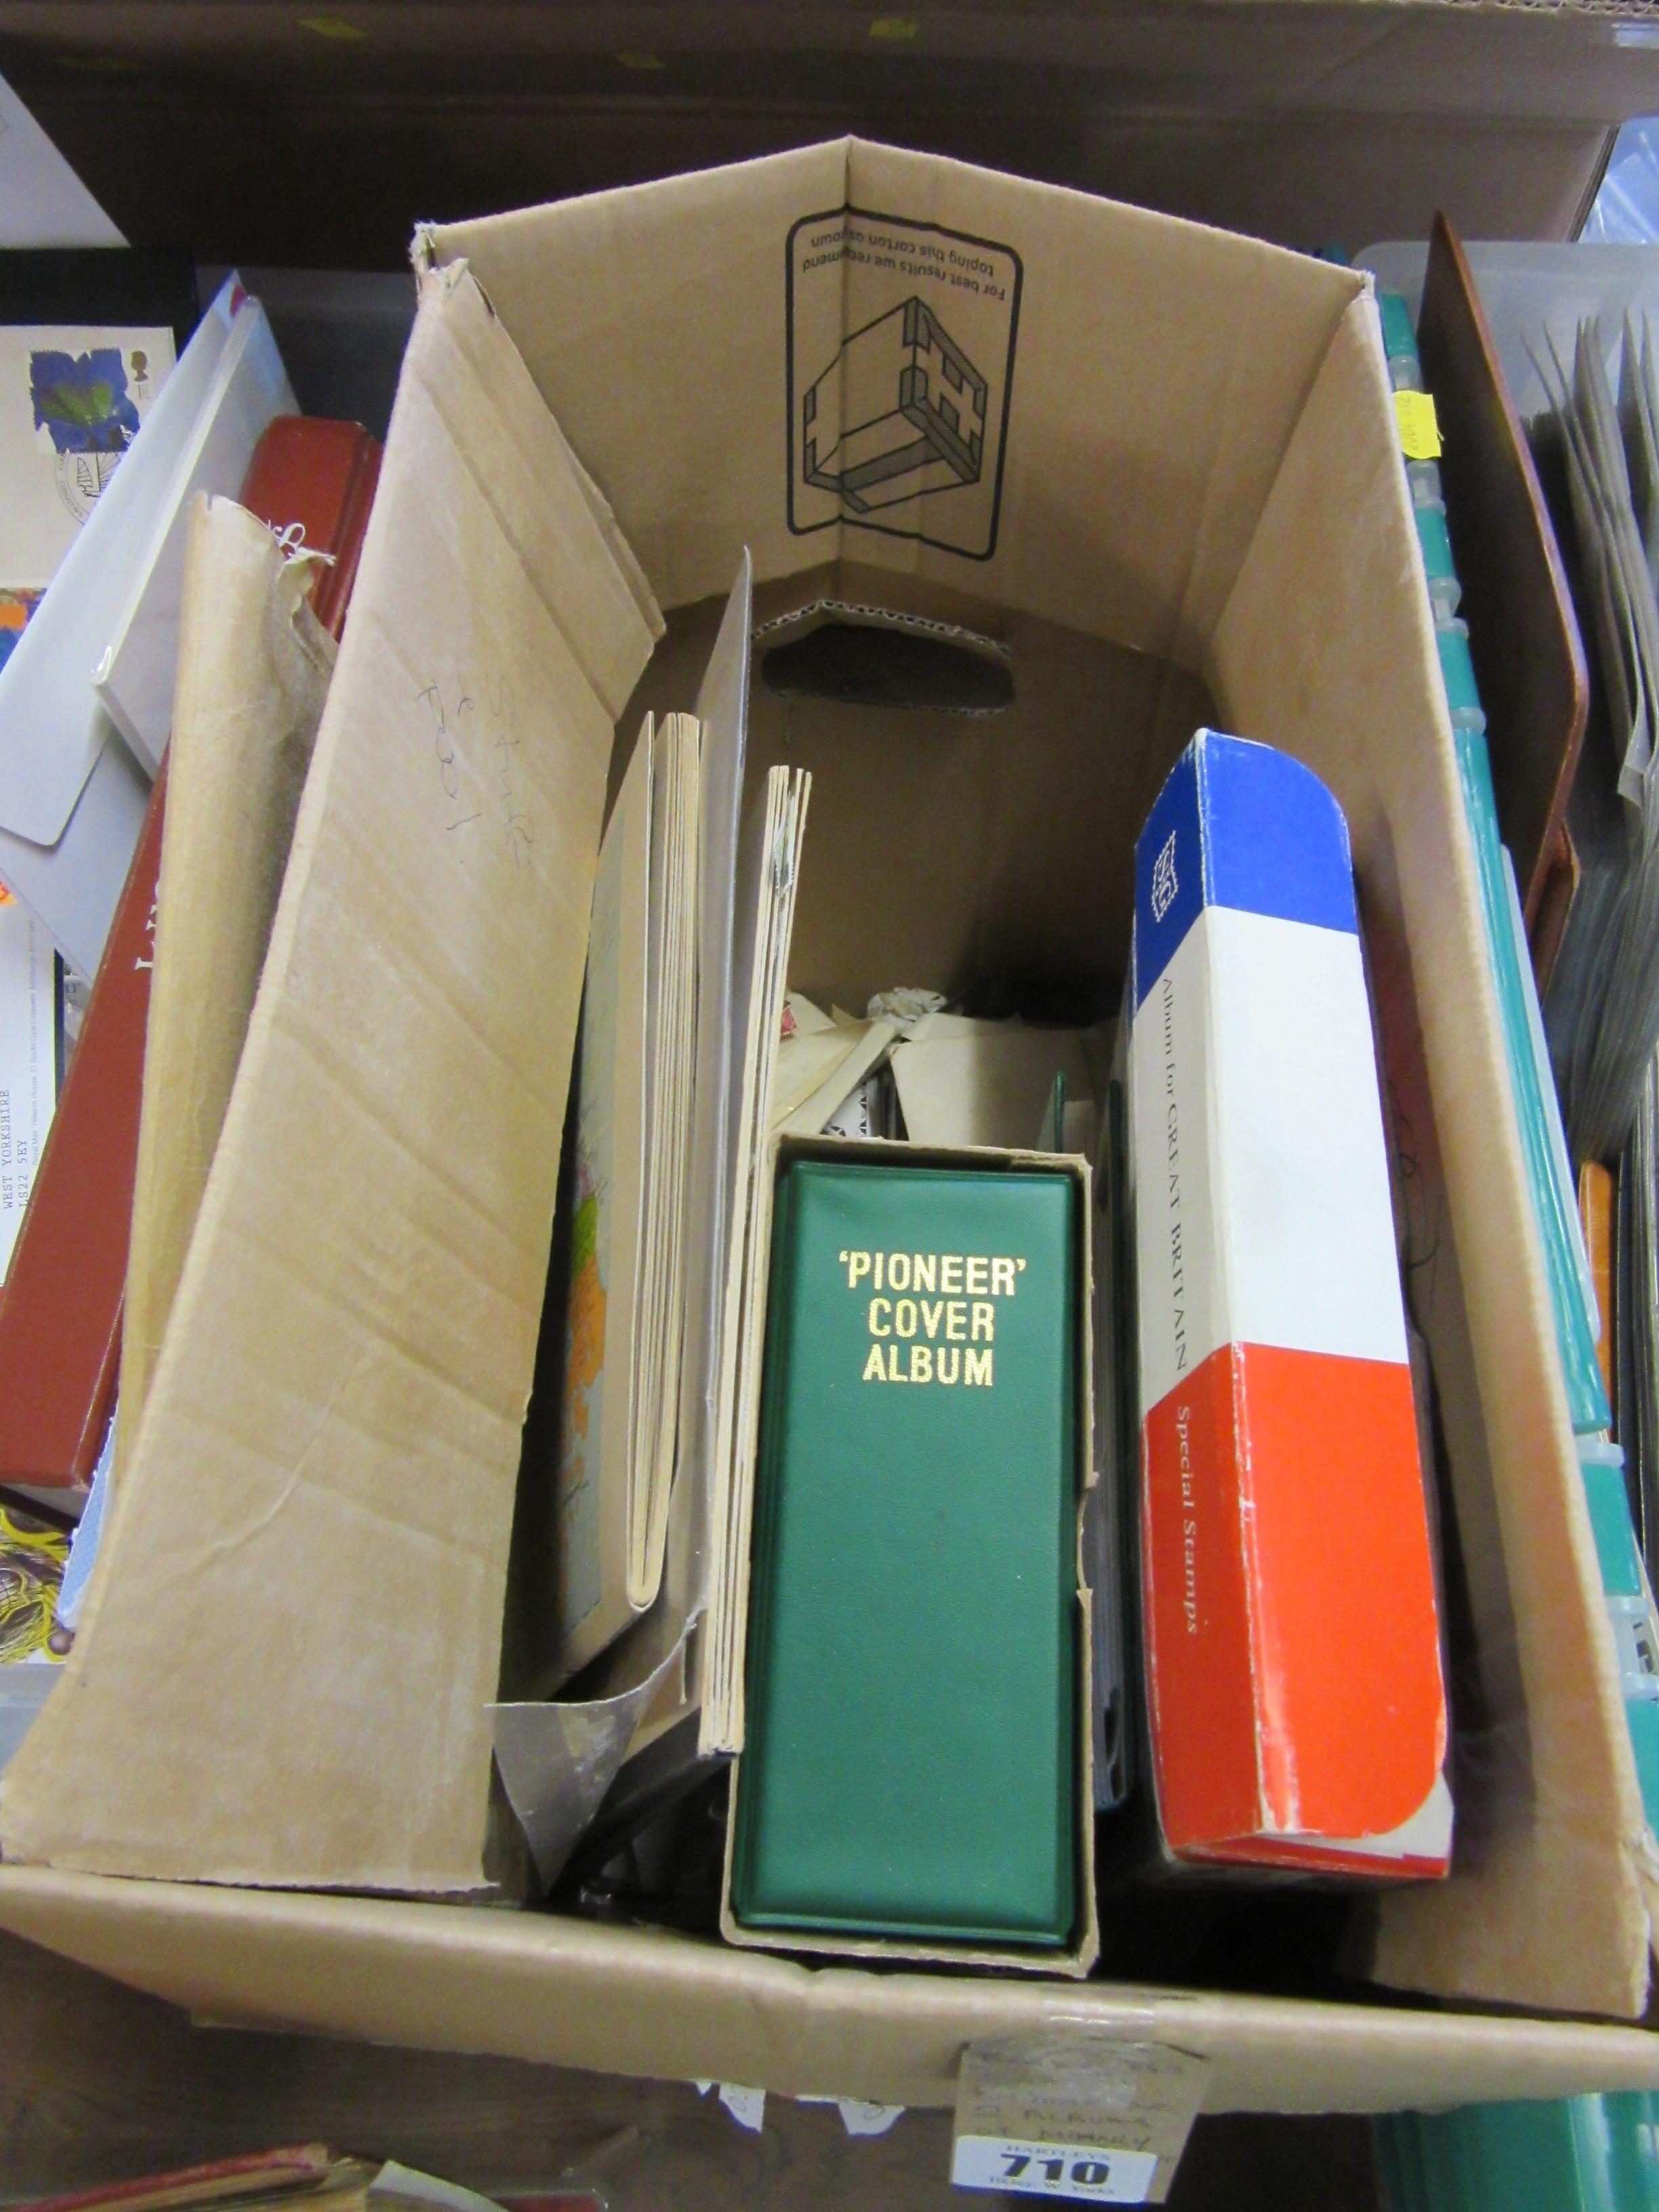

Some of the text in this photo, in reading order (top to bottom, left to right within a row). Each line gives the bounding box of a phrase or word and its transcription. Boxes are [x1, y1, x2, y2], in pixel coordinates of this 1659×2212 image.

[868, 234, 916, 255] carton
[873, 254, 895, 268] we
[920, 243, 947, 262] this
[899, 258, 946, 283] results
[951, 272, 980, 292] best
[983, 283, 1006, 301] For
[0, 1089, 14, 1210] WEST YORKSHIRE
[16, 1139, 29, 1208] LS22 5EY
[1162, 977, 1187, 1372] Album for GREAT BRITAIN
[867, 1297, 996, 1342] COVER
[861, 1343, 994, 1387] ALBUM
[1176, 1406, 1197, 1635] Special Stamps
[1000, 2152, 1111, 2185] 710
